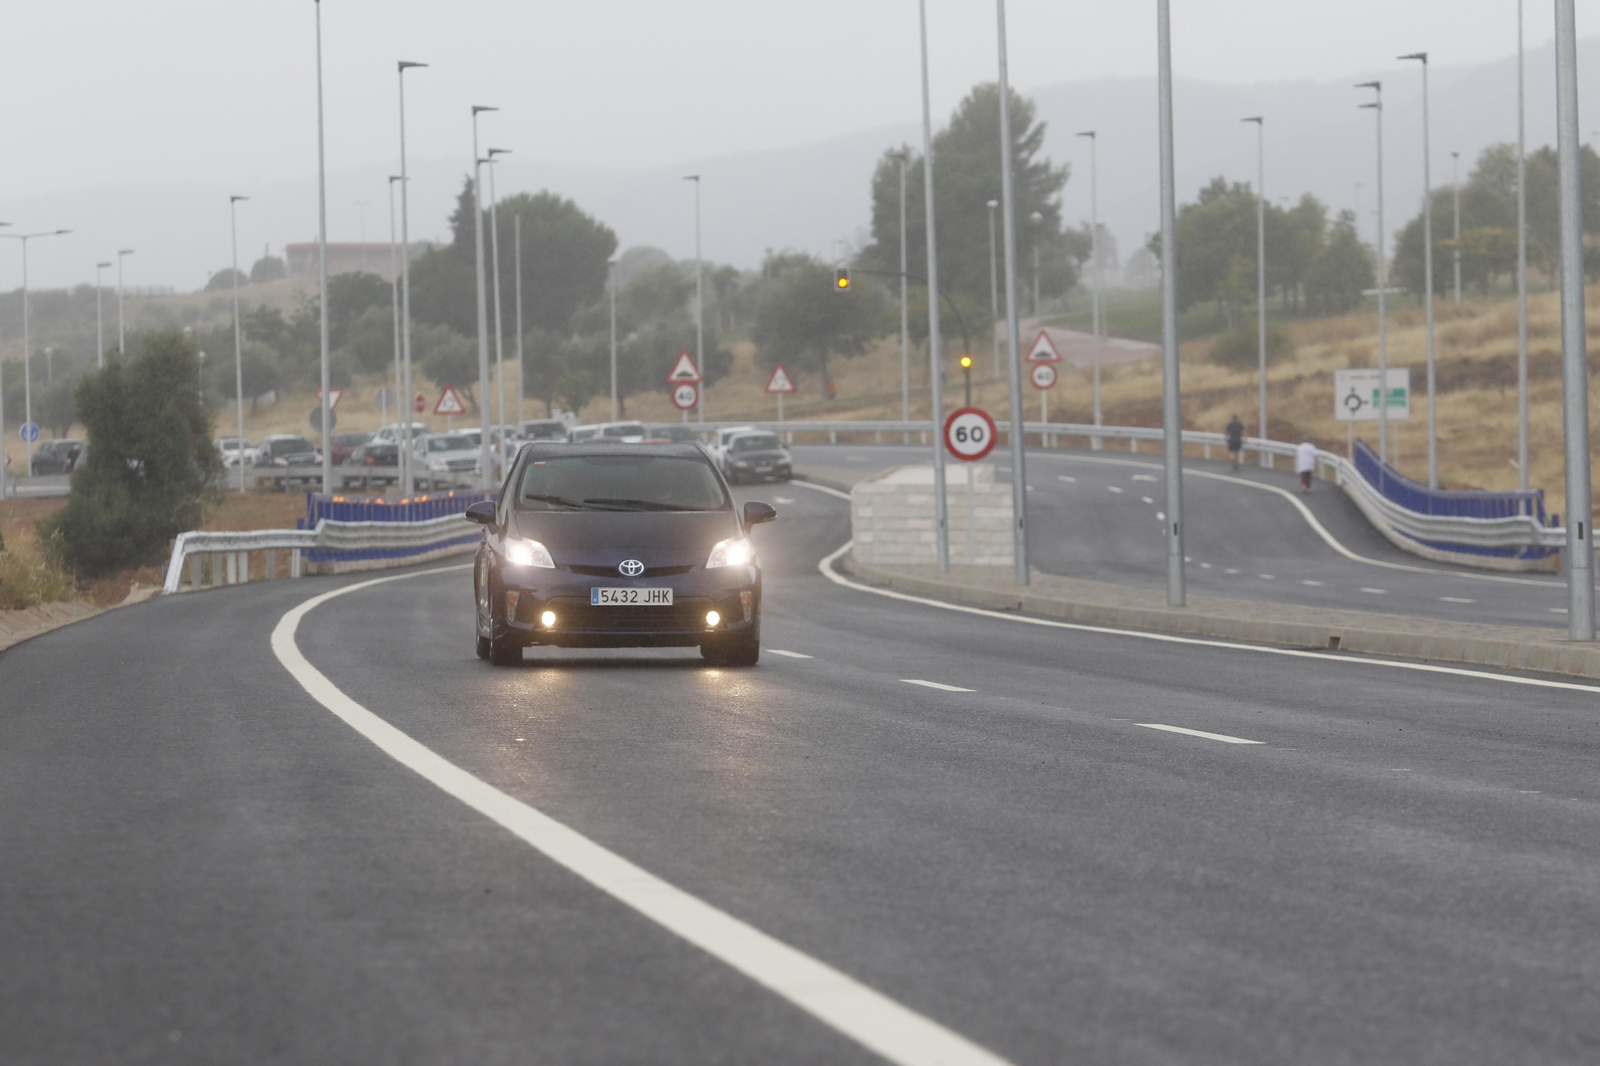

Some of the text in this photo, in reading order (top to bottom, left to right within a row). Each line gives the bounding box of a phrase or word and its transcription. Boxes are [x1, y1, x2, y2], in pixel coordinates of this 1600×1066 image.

[678, 391, 692, 400] 40
[956, 426, 983, 443] 60
[601, 590, 670, 603] 5432 JHK
